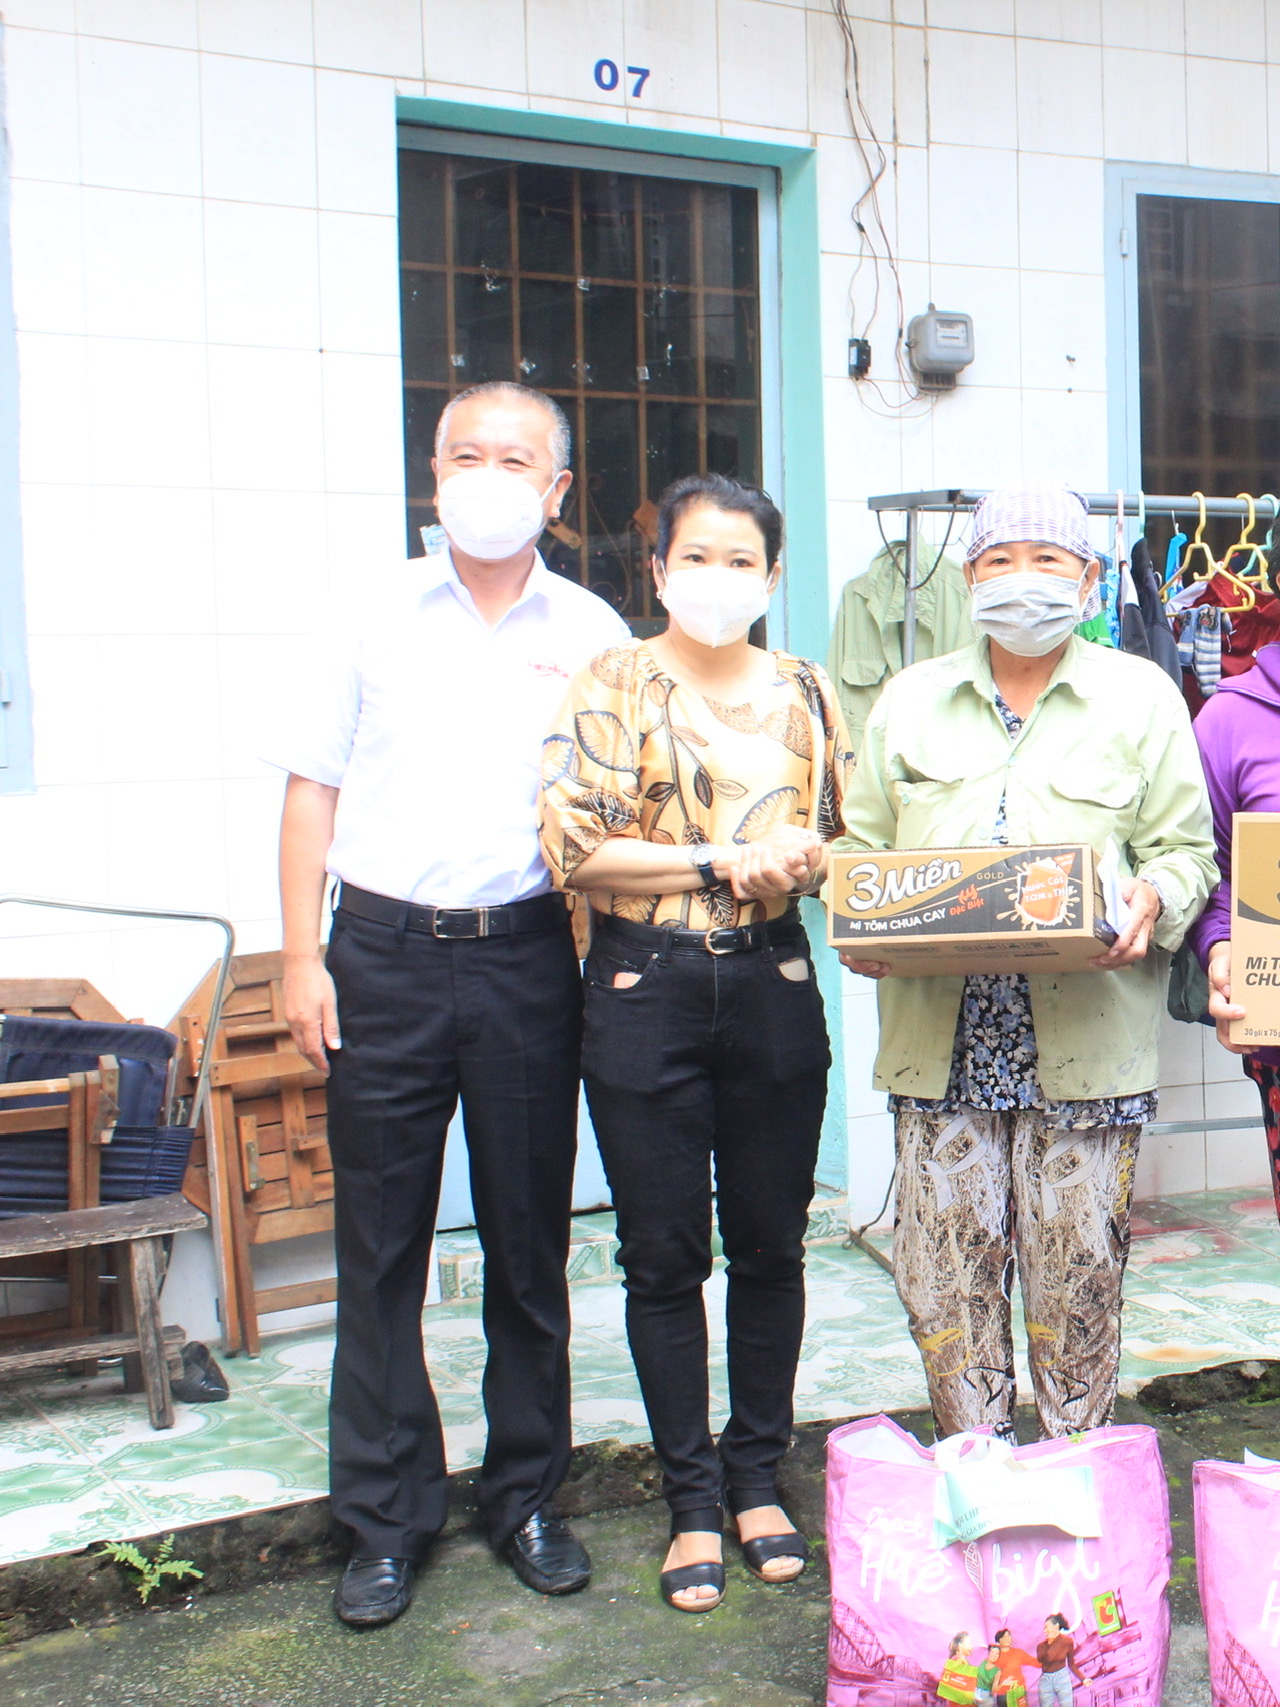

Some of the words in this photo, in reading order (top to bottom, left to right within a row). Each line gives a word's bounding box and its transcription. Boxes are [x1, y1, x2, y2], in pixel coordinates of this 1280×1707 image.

[594, 58, 650, 98] 07
[976, 872, 1005, 881] GOLD
[864, 919, 888, 931] TÔM
[889, 916, 922, 930] CHUA
[922, 908, 947, 923] CAY
[1245, 956, 1267, 970] Mì
